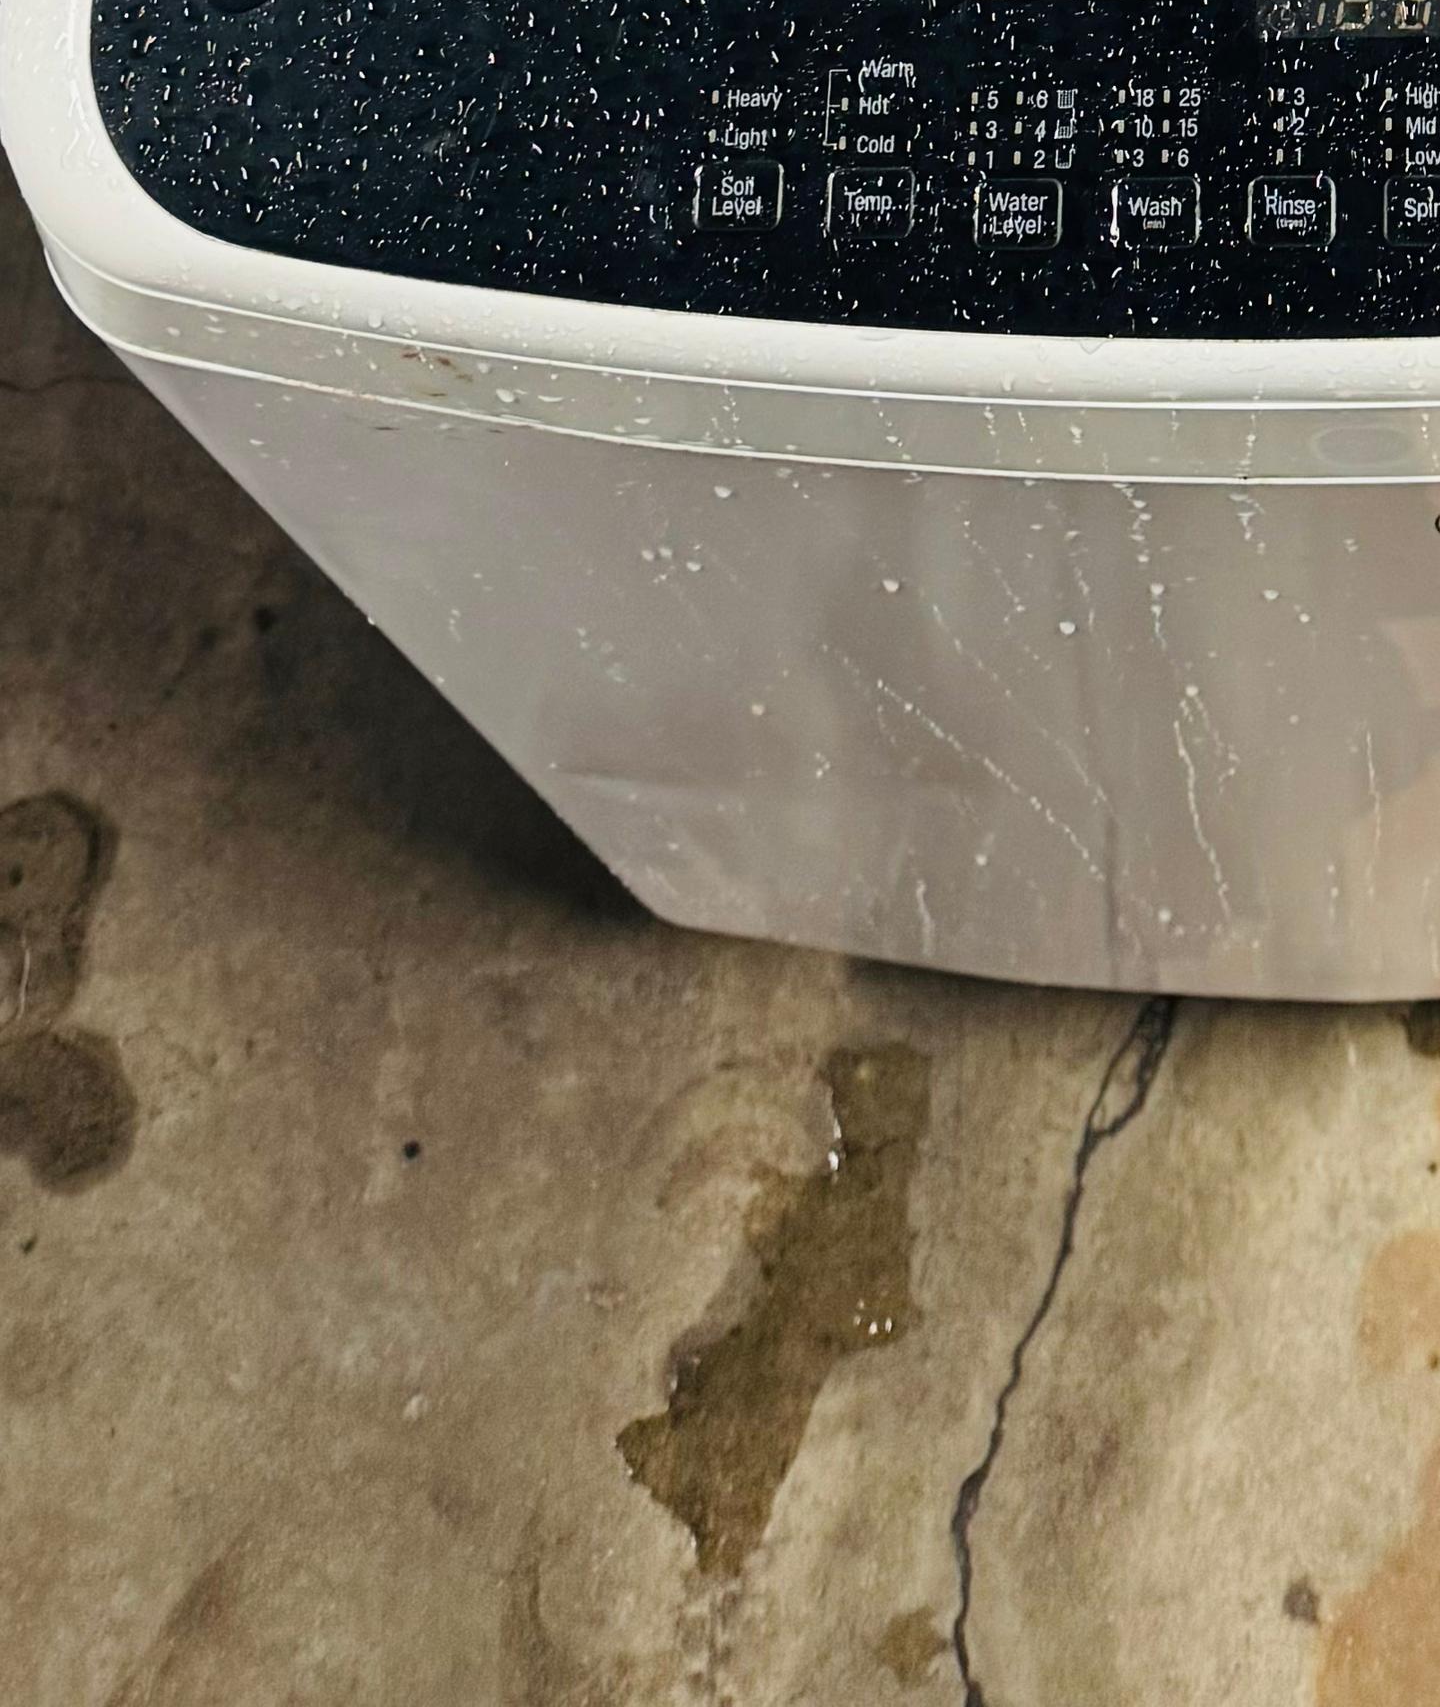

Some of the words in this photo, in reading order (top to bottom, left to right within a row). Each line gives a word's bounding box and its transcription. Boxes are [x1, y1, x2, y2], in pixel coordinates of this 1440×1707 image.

[863, 61, 914, 78] Warm
[728, 89, 783, 111] Heavy
[859, 94, 890, 115] Hot
[987, 90, 999, 109] 5
[1136, 89, 1154, 107] 18
[1179, 89, 1201, 107] 25
[1294, 87, 1305, 106] 3
[986, 120, 997, 139] 3
[1034, 120, 1046, 139] 4
[1135, 119, 1153, 137] 10
[1180, 118, 1198, 137] 15
[1293, 117, 1305, 135] 2
[1406, 116, 1437, 134] Mid
[724, 128, 768, 150] Light
[857, 135, 895, 153] Cold
[986, 151, 993, 169] 1
[1033, 150, 1046, 169] 2
[1133, 149, 1144, 167] 3
[1177, 149, 1189, 167] 6
[1295, 147, 1302, 166] 1
[721, 176, 755, 196] Soil
[712, 196, 761, 216] Level
[845, 191, 896, 215] Temp.
[989, 192, 1048, 212] Water
[1129, 197, 1183, 216] Wash
[1266, 195, 1316, 215] Rinse
[993, 215, 1042, 235] Level
